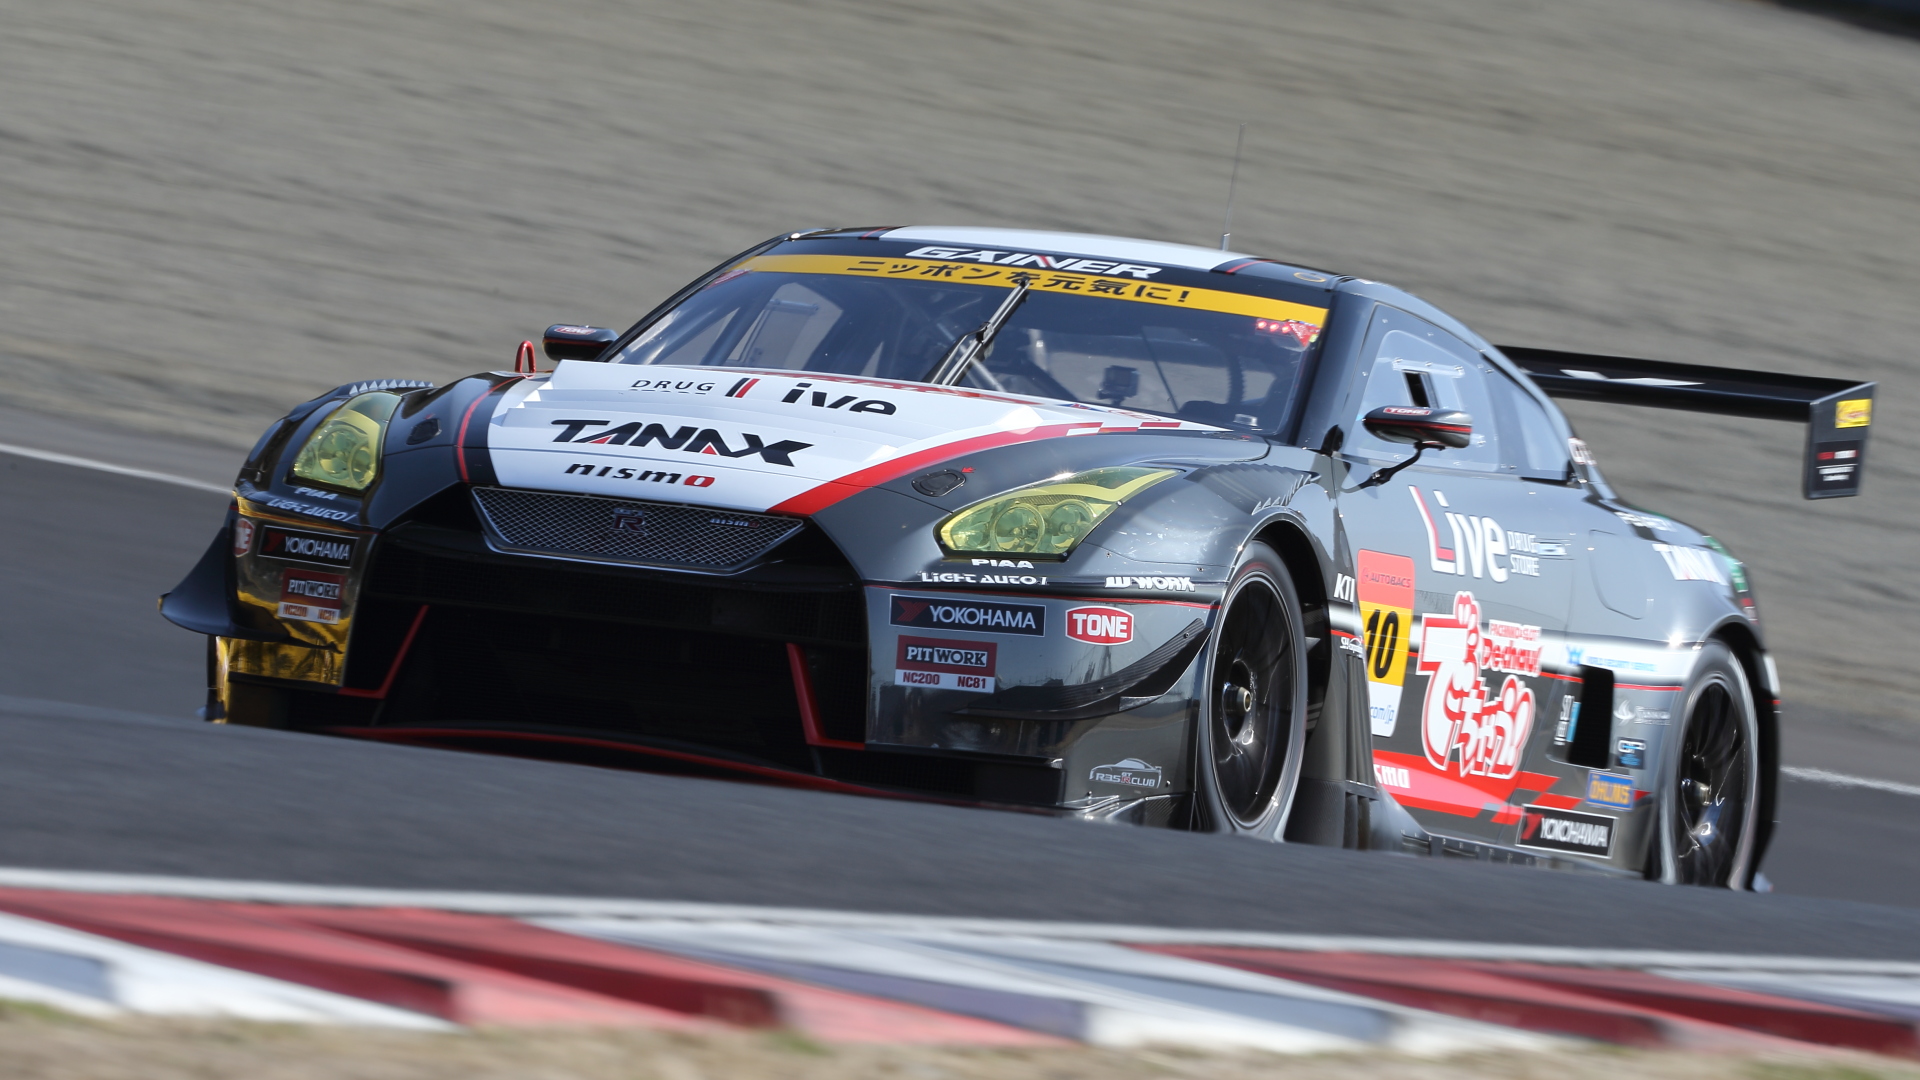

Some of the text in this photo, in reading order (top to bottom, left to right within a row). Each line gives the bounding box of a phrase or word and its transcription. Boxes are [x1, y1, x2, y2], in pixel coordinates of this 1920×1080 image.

[905, 246, 1161, 279] GAINER
[631, 379, 716, 392] DRUG
[550, 419, 814, 467] TANAX
[564, 463, 715, 488] nismo
[295, 487, 339, 500] PIAA
[612, 515, 645, 532] R
[1408, 485, 1509, 583] Live
[284, 536, 350, 560] YOKOHAMA
[971, 558, 1034, 570] PIAA
[1510, 553, 1540, 577] STORE
[1134, 577, 1195, 592] WORK
[1370, 572, 1412, 588] AUTOBACS
[930, 605, 1037, 629] YOKOHAMA
[1072, 613, 1128, 639] TONE
[1364, 609, 1399, 679] 10
[902, 672, 987, 689] NC200 NC81
[1131, 777, 1156, 788] CLUB
[1540, 817, 1609, 848] YOKOHAMA
